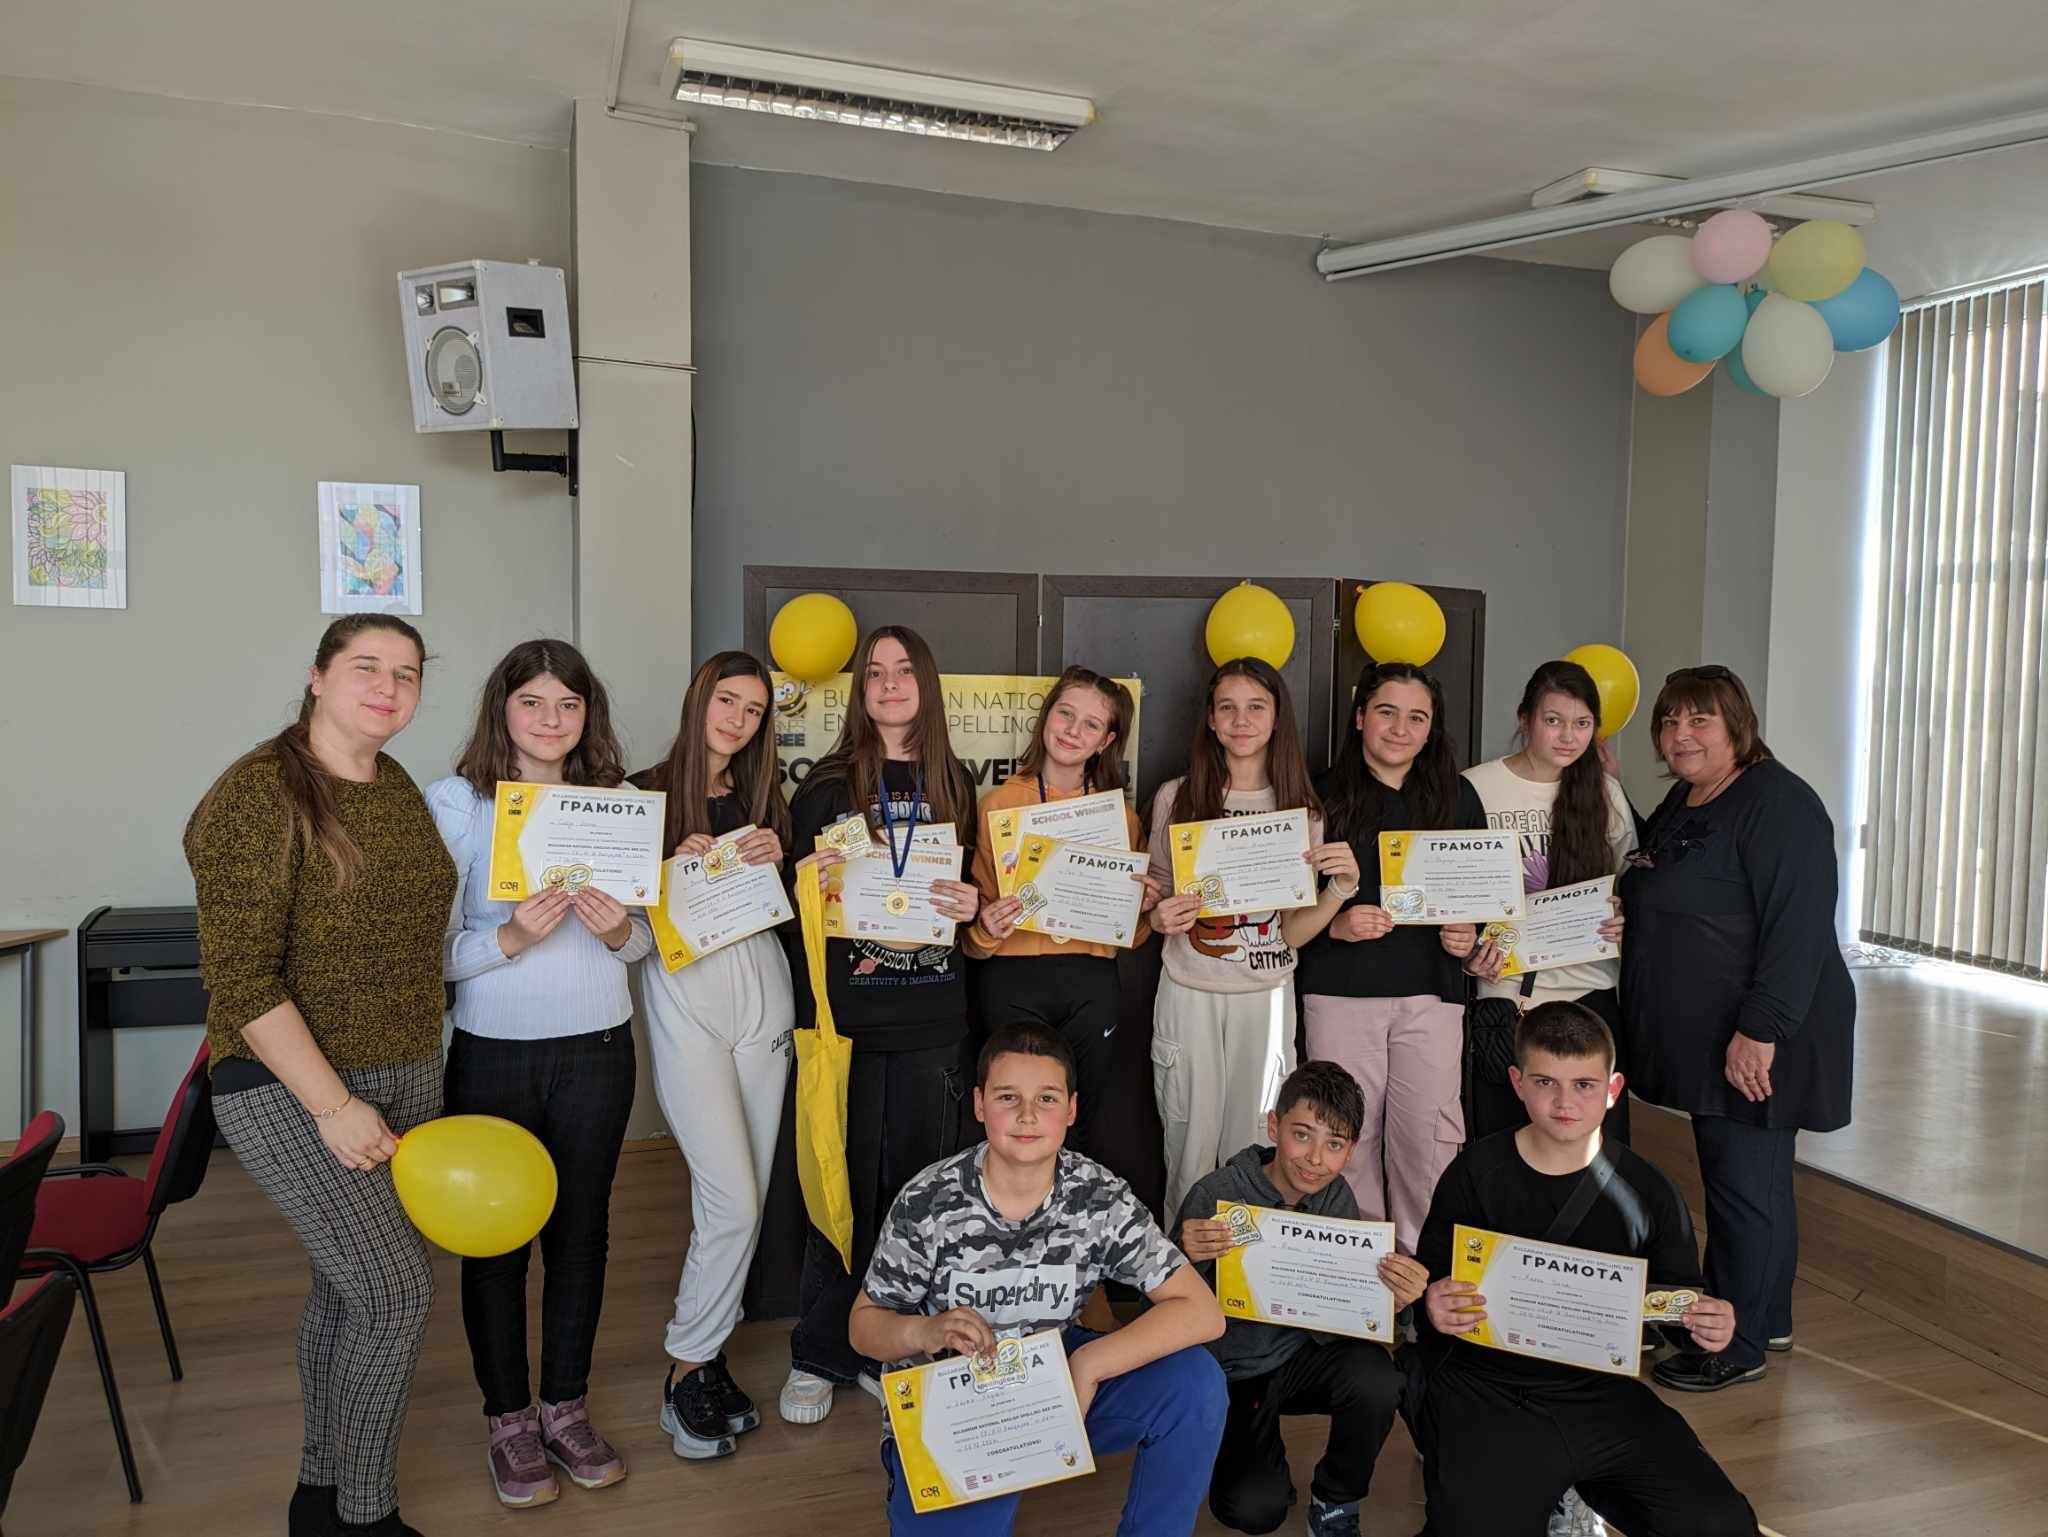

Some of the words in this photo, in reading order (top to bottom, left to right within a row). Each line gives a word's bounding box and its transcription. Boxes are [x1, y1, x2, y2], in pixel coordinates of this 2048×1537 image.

[973, 691, 1044, 710] NATIO
[560, 800, 647, 816] ГРАМОТА
[1032, 812, 1073, 826] SCHOOL
[1075, 803, 1116, 818] WINNER
[1222, 822, 1293, 840] ГРАМОТА
[1431, 841, 1504, 851] ГРАМОТА
[865, 850, 902, 861] SCHO
[911, 855, 952, 865] WINNER
[1069, 854, 1135, 873] ГРАМОТА
[1534, 886, 1600, 906] ГРАМОТА
[861, 942, 914, 971] ILLUSION
[848, 976, 898, 986] CREATIVITY
[1281, 1225, 1374, 1250] ГРАМОТА
[1522, 1255, 1623, 1282] ГРАМОТА
[955, 1276, 1069, 1312] Superdry.
